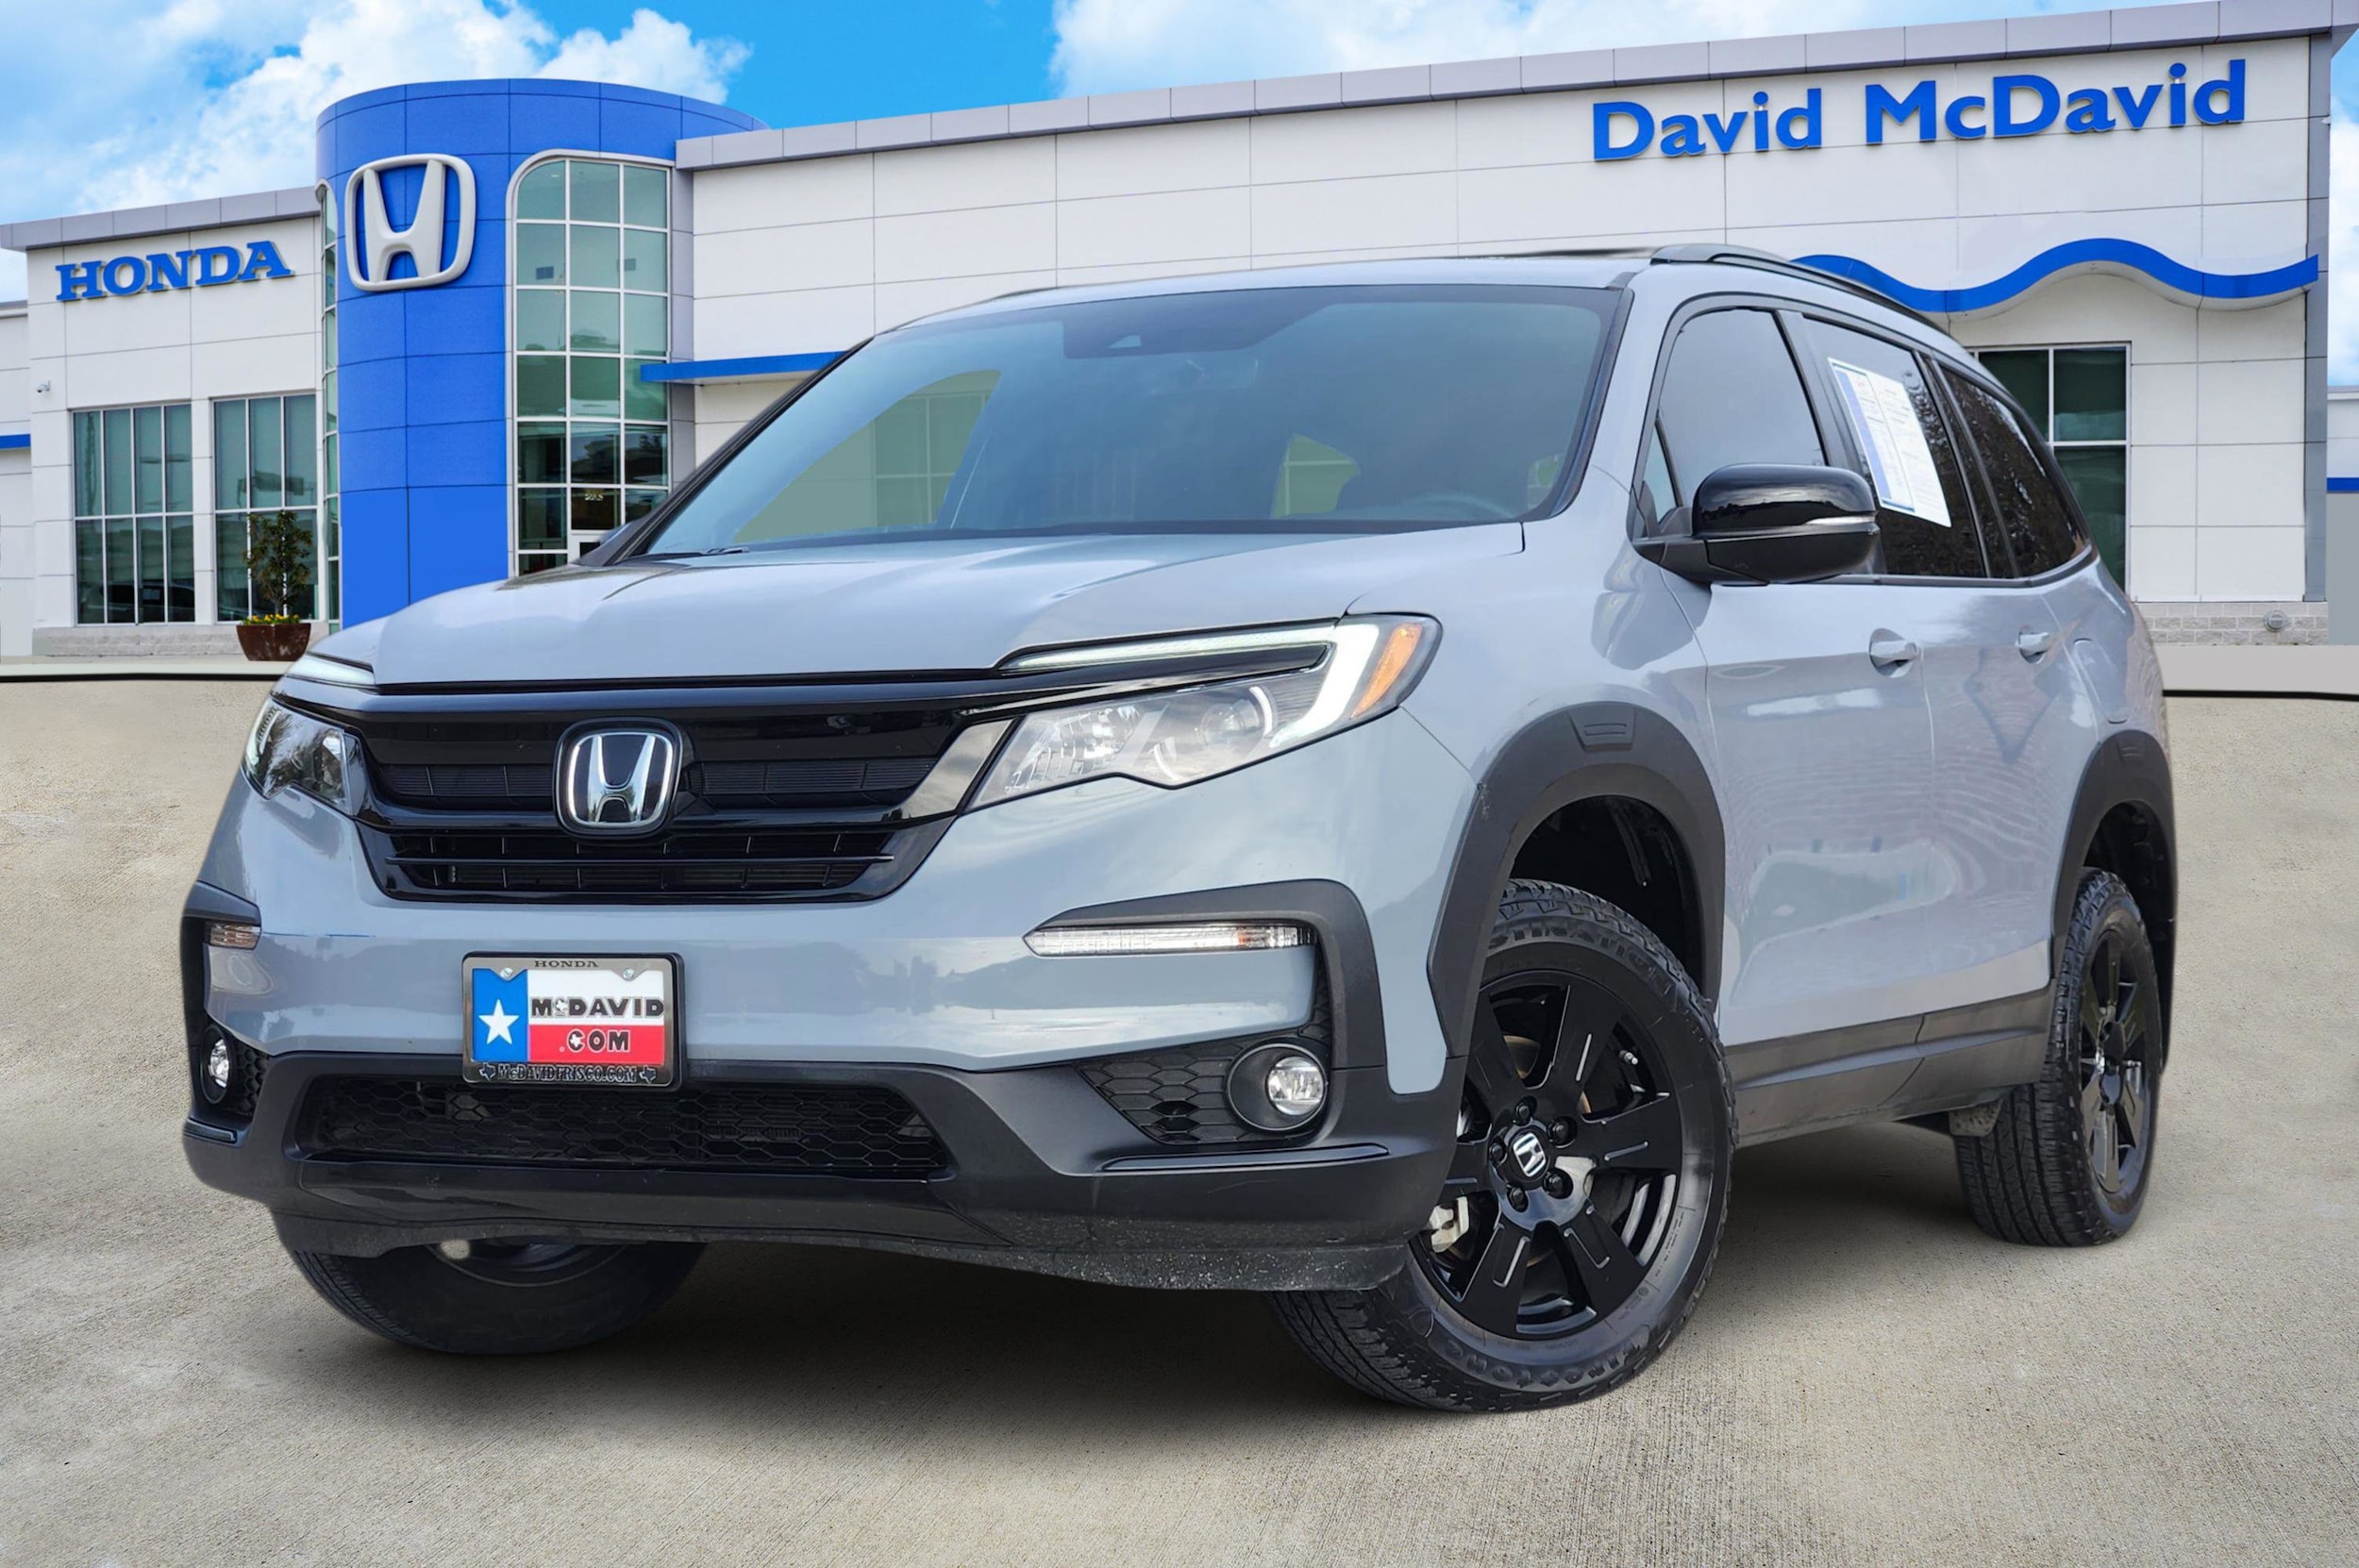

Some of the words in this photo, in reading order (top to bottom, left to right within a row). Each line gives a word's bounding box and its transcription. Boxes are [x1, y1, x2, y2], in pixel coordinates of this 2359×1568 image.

[1593, 86, 1823, 162] David
[1865, 58, 2246, 145] McDavid
[56, 240, 294, 302] HONDA
